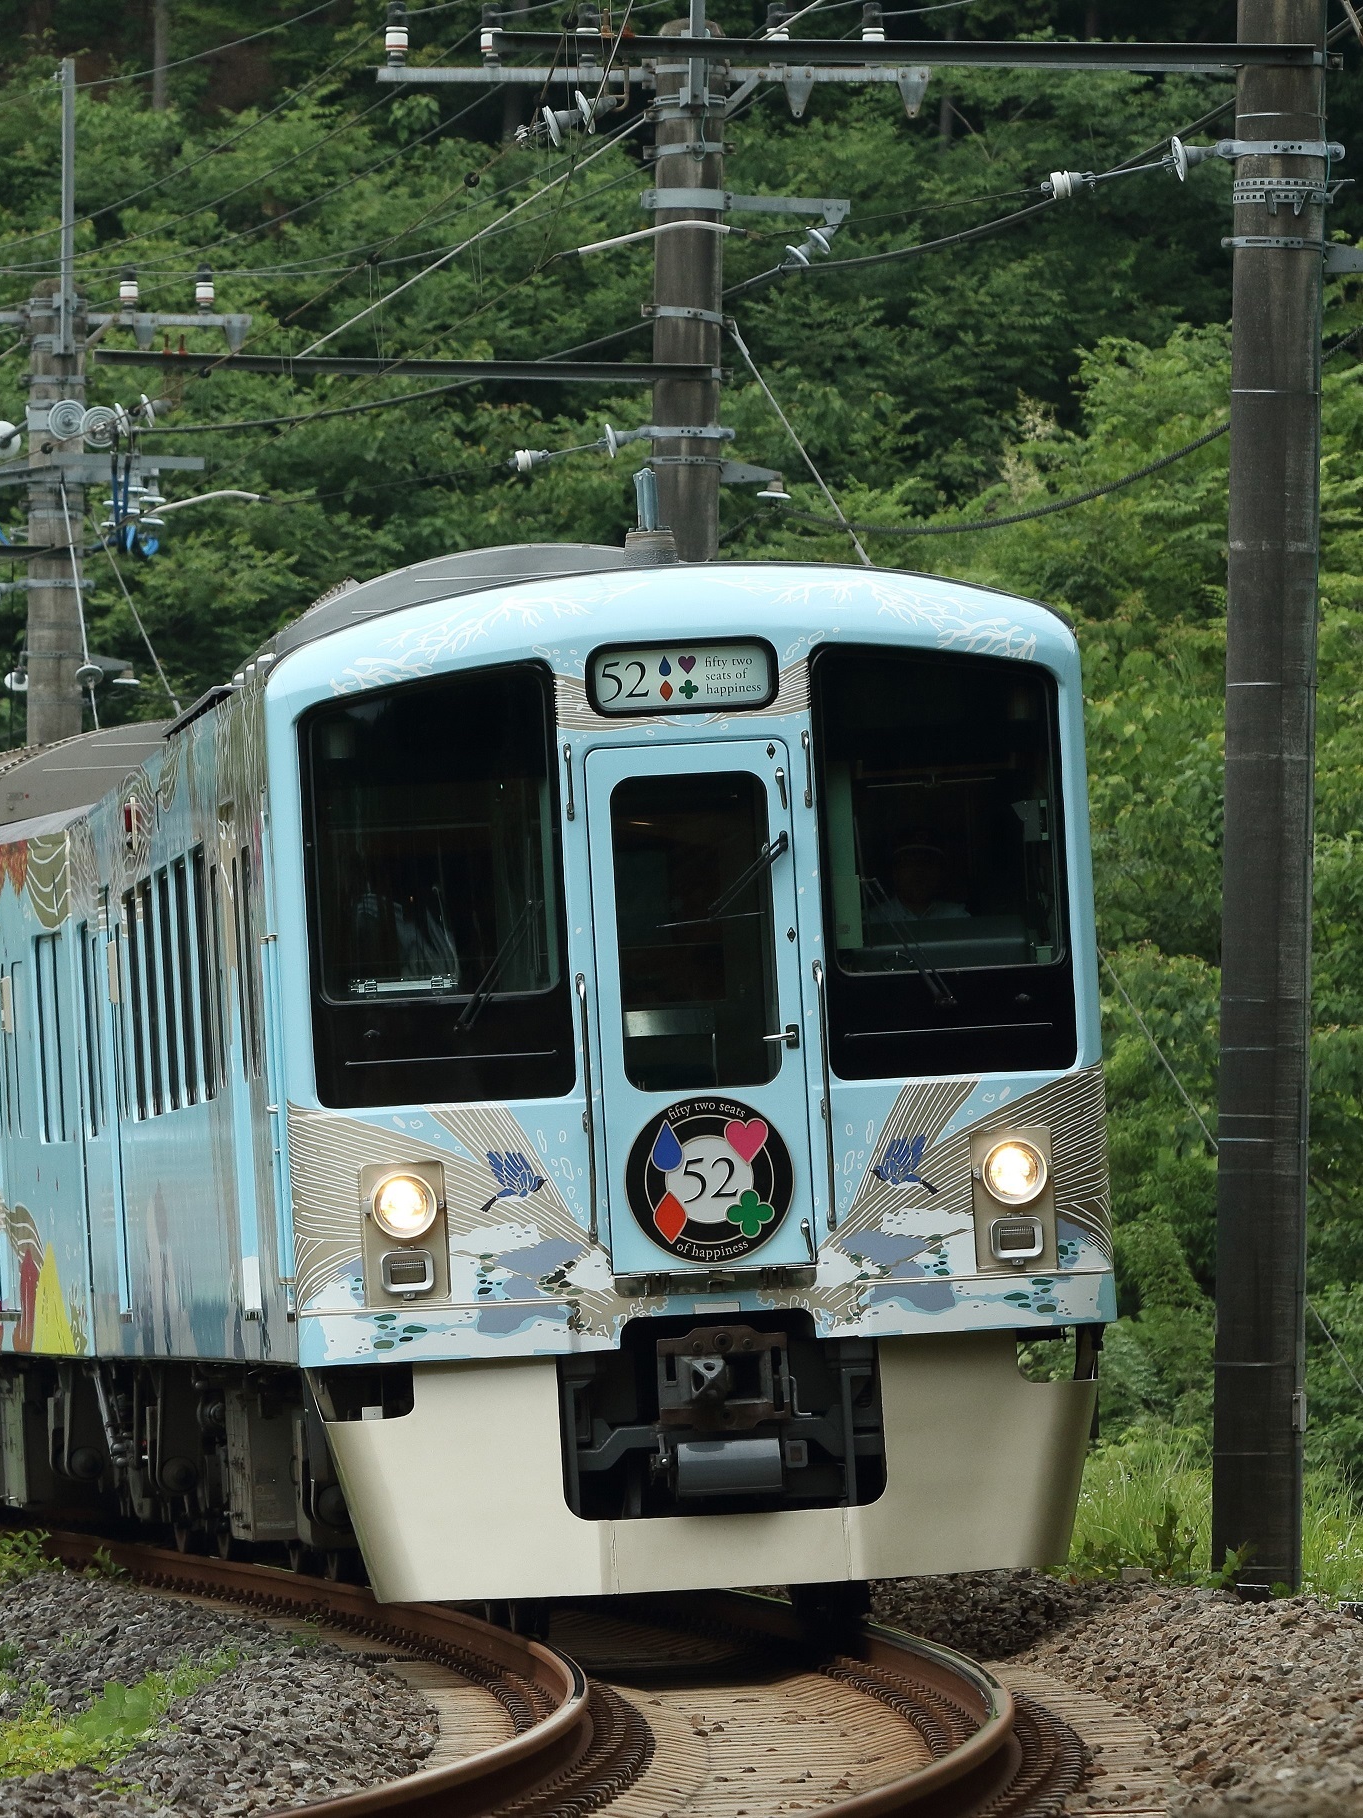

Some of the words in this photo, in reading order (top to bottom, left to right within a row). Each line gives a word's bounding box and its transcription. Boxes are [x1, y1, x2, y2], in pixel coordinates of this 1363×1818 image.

[704, 655, 728, 670] fifty
[732, 656, 753, 666] two
[601, 661, 650, 703] 52
[705, 672, 732, 681] seats
[735, 668, 747, 680] of
[706, 682, 762, 697] happiness
[667, 1104, 691, 1121] fifty
[694, 1101, 716, 1111] two
[719, 1103, 746, 1118] seats
[682, 1156, 739, 1203] 52
[676, 1242, 692, 1254] of
[692, 1240, 749, 1260] happiness
